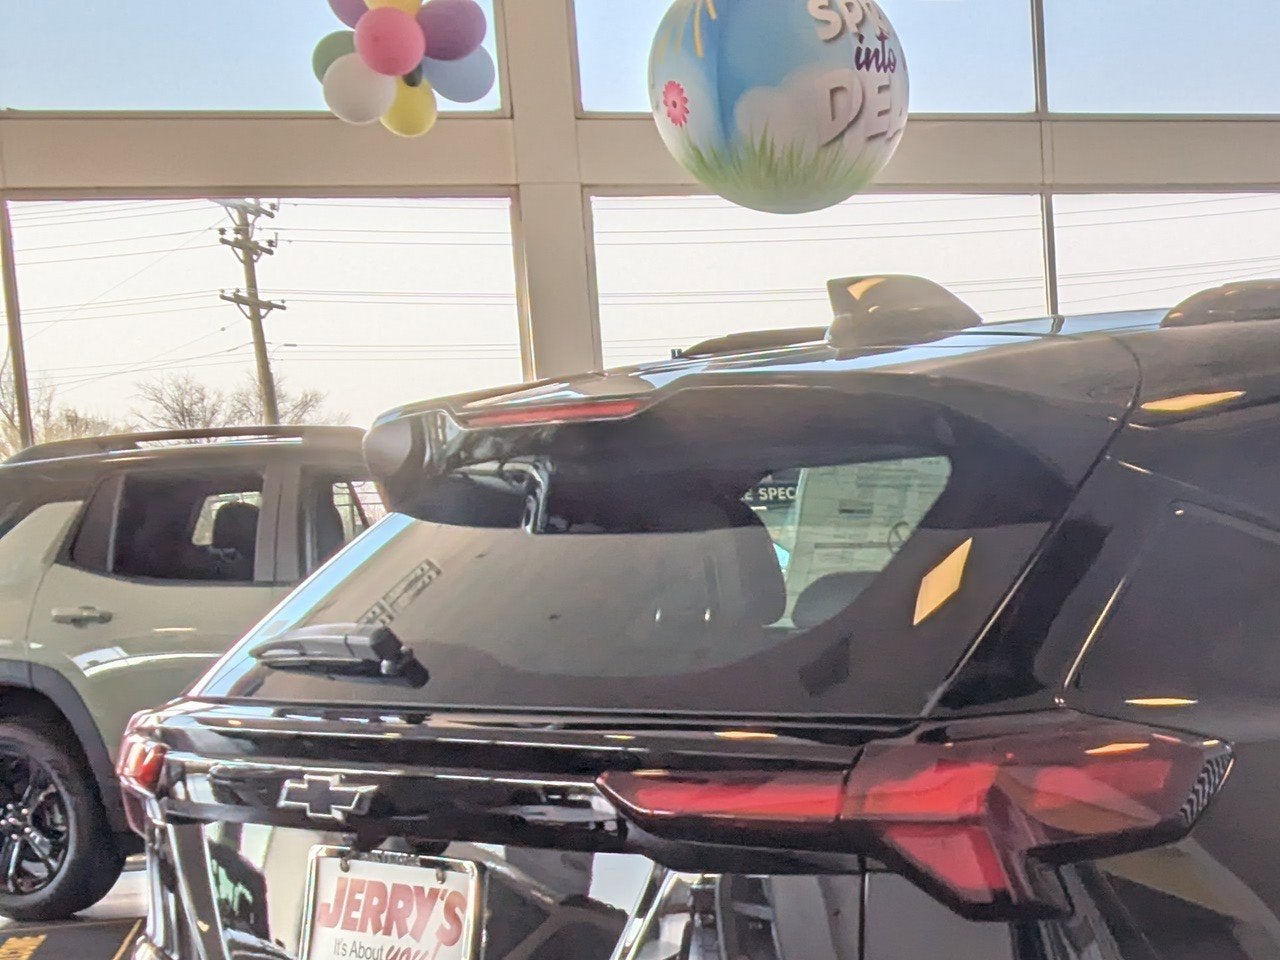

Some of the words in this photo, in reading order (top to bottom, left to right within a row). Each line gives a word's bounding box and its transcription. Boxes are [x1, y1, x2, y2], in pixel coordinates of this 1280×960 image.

[855, 33, 897, 73] into
[759, 486, 796, 500] SPEC
[317, 876, 468, 948] JERRY'S
[333, 937, 348, 957] It's
